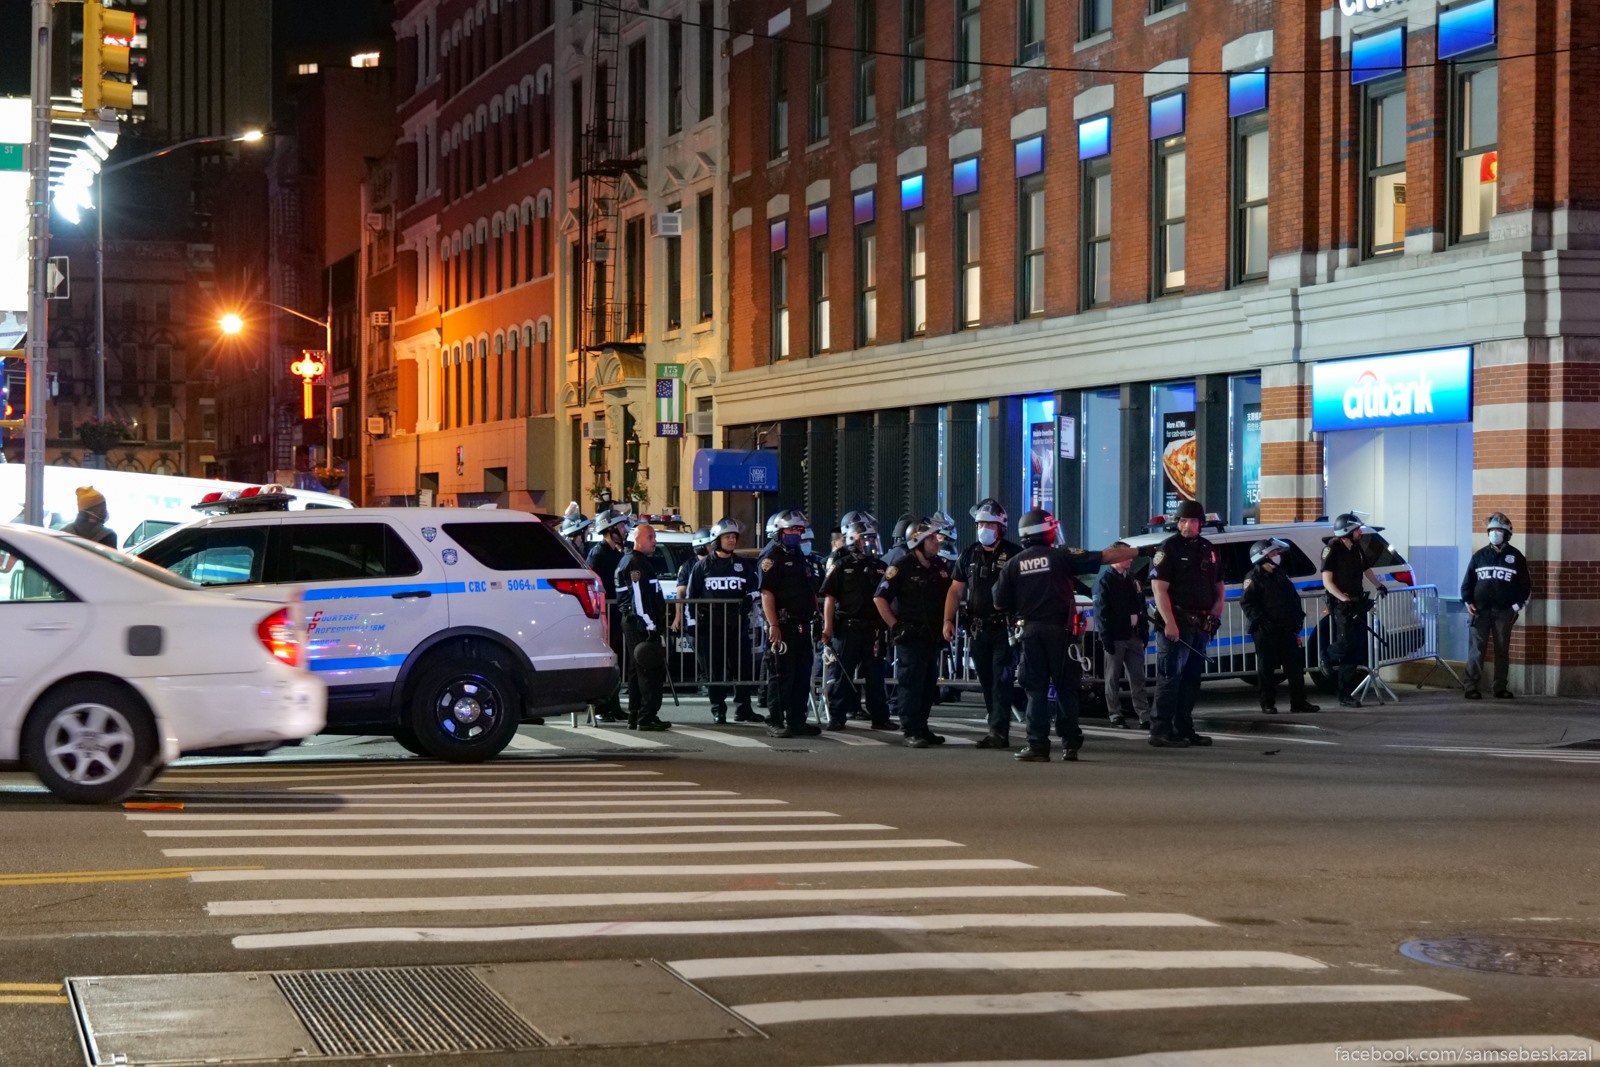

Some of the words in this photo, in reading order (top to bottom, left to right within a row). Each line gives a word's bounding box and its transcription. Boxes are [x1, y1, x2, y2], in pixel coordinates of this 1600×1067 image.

[5, 146, 14, 154] ST
[663, 365, 678, 373] 175
[1343, 371, 1434, 419] citibank
[1020, 557, 1048, 571] NYPD
[1477, 570, 1512, 582] POLICE
[469, 581, 487, 592] CRC
[508, 579, 531, 591] 5064
